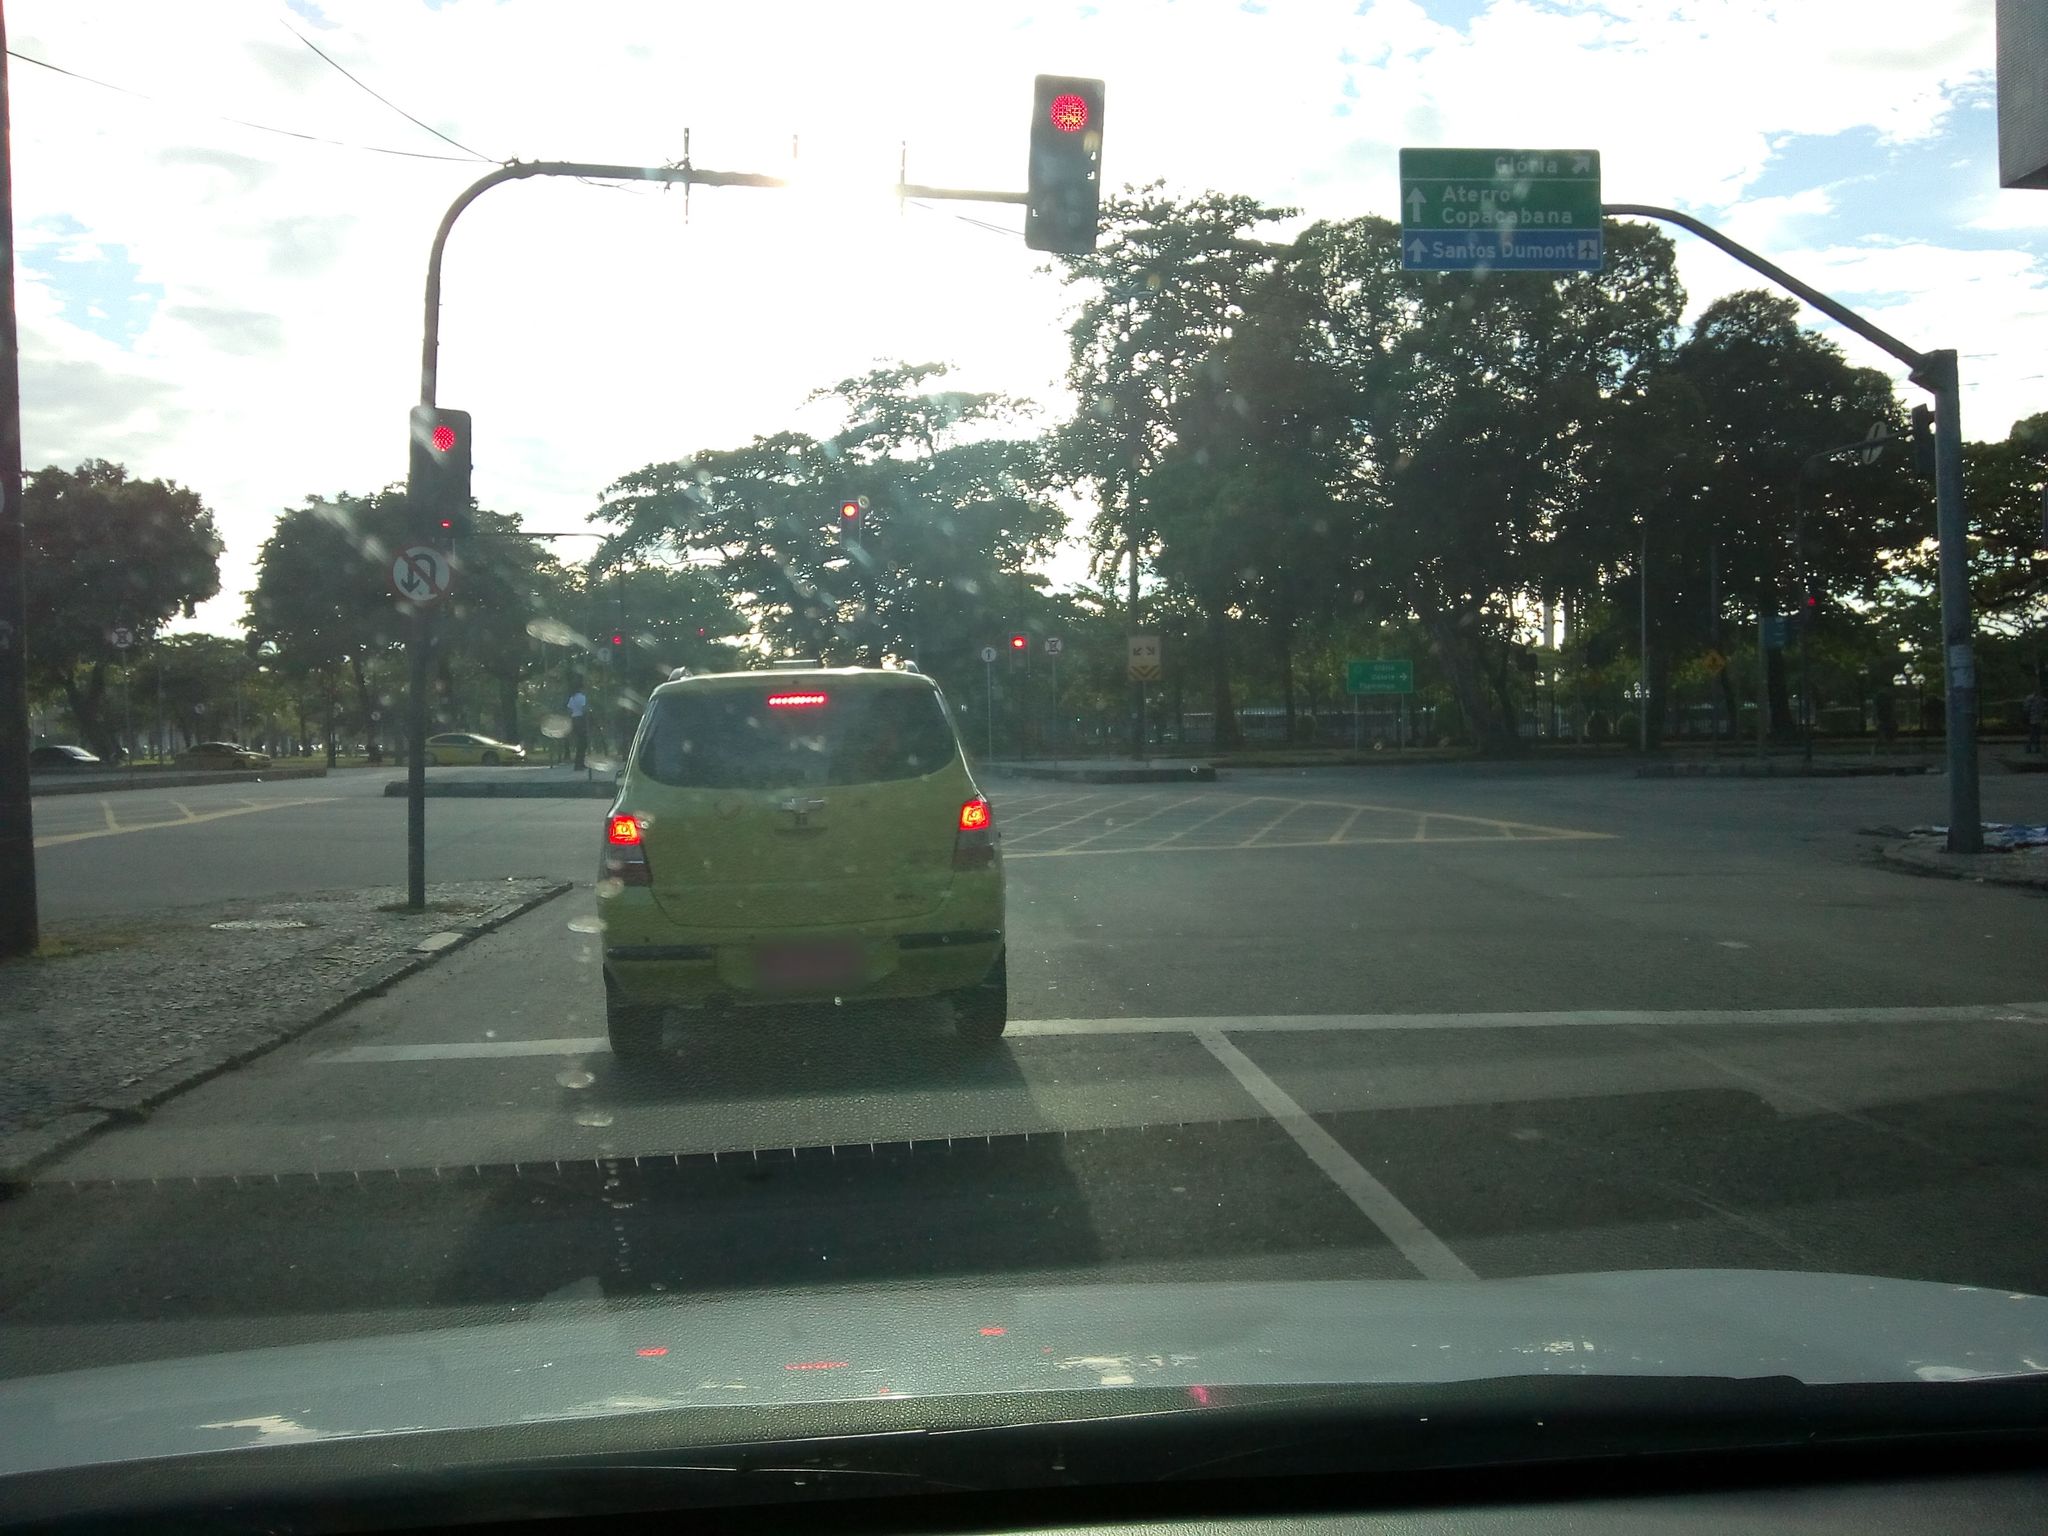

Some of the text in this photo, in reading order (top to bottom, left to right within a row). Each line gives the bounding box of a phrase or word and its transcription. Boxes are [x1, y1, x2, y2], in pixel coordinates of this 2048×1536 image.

[1442, 186, 1511, 202] Aterro
[1441, 208, 1573, 227] Copacabana
[1433, 241, 1575, 259] Santos Dumont
